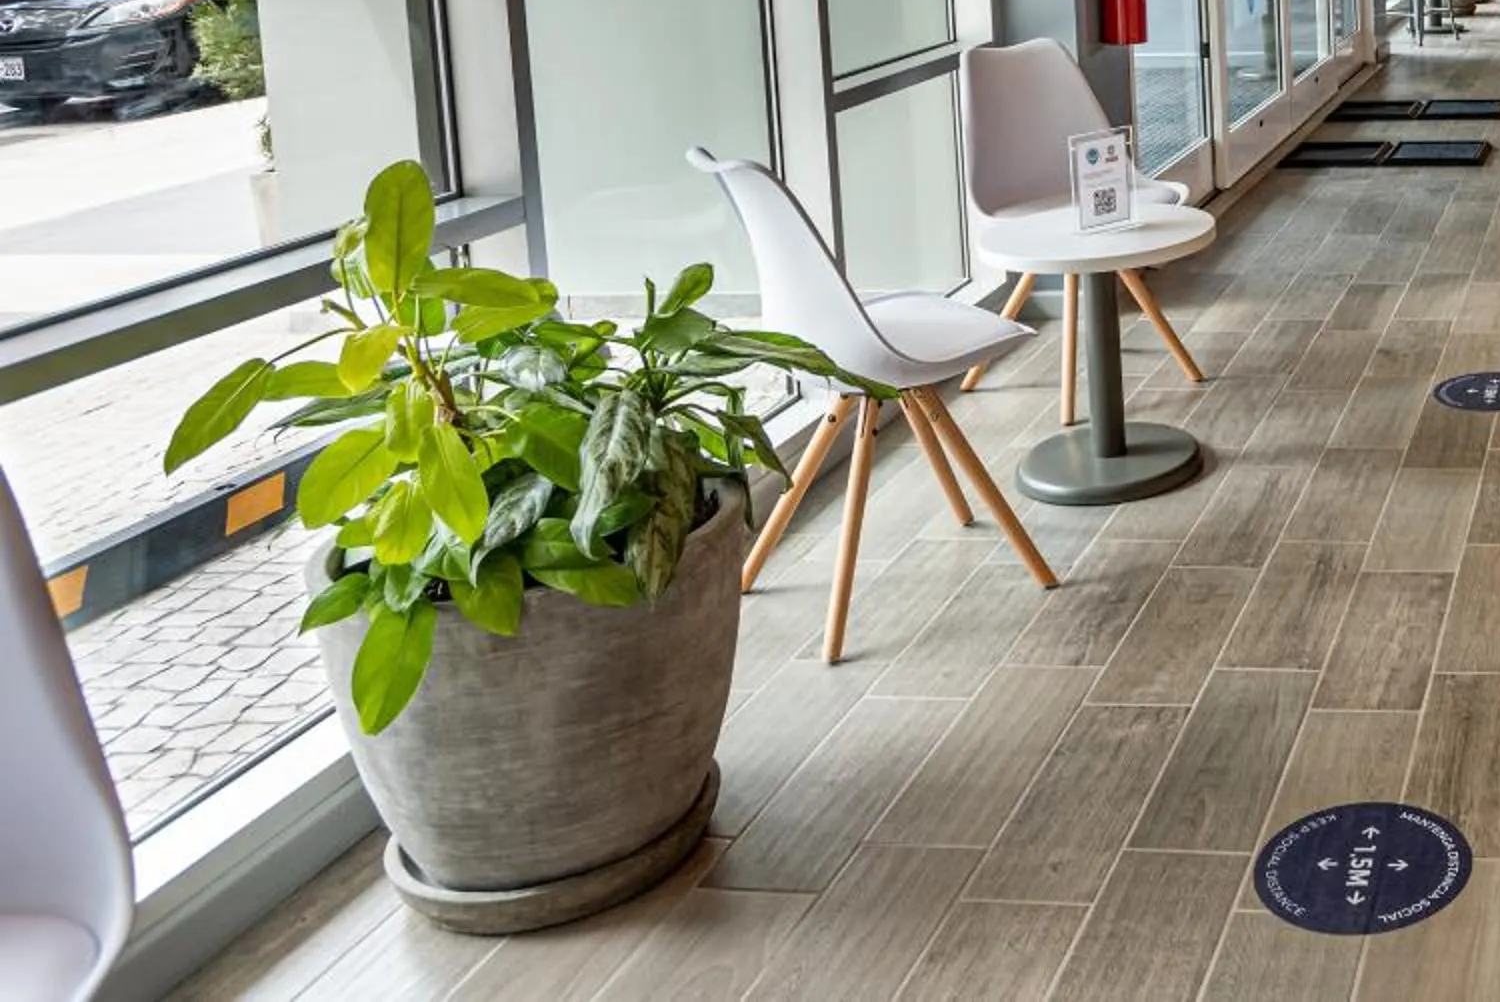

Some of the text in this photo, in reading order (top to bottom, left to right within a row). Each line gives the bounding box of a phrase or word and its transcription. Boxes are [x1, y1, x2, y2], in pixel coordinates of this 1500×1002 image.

[1267, 832, 1300, 869] SOCIAL
[1377, 811, 1460, 923] MANTENGA DISTANCIA SOCIAL
[1266, 869, 1307, 917] DISTANCE
